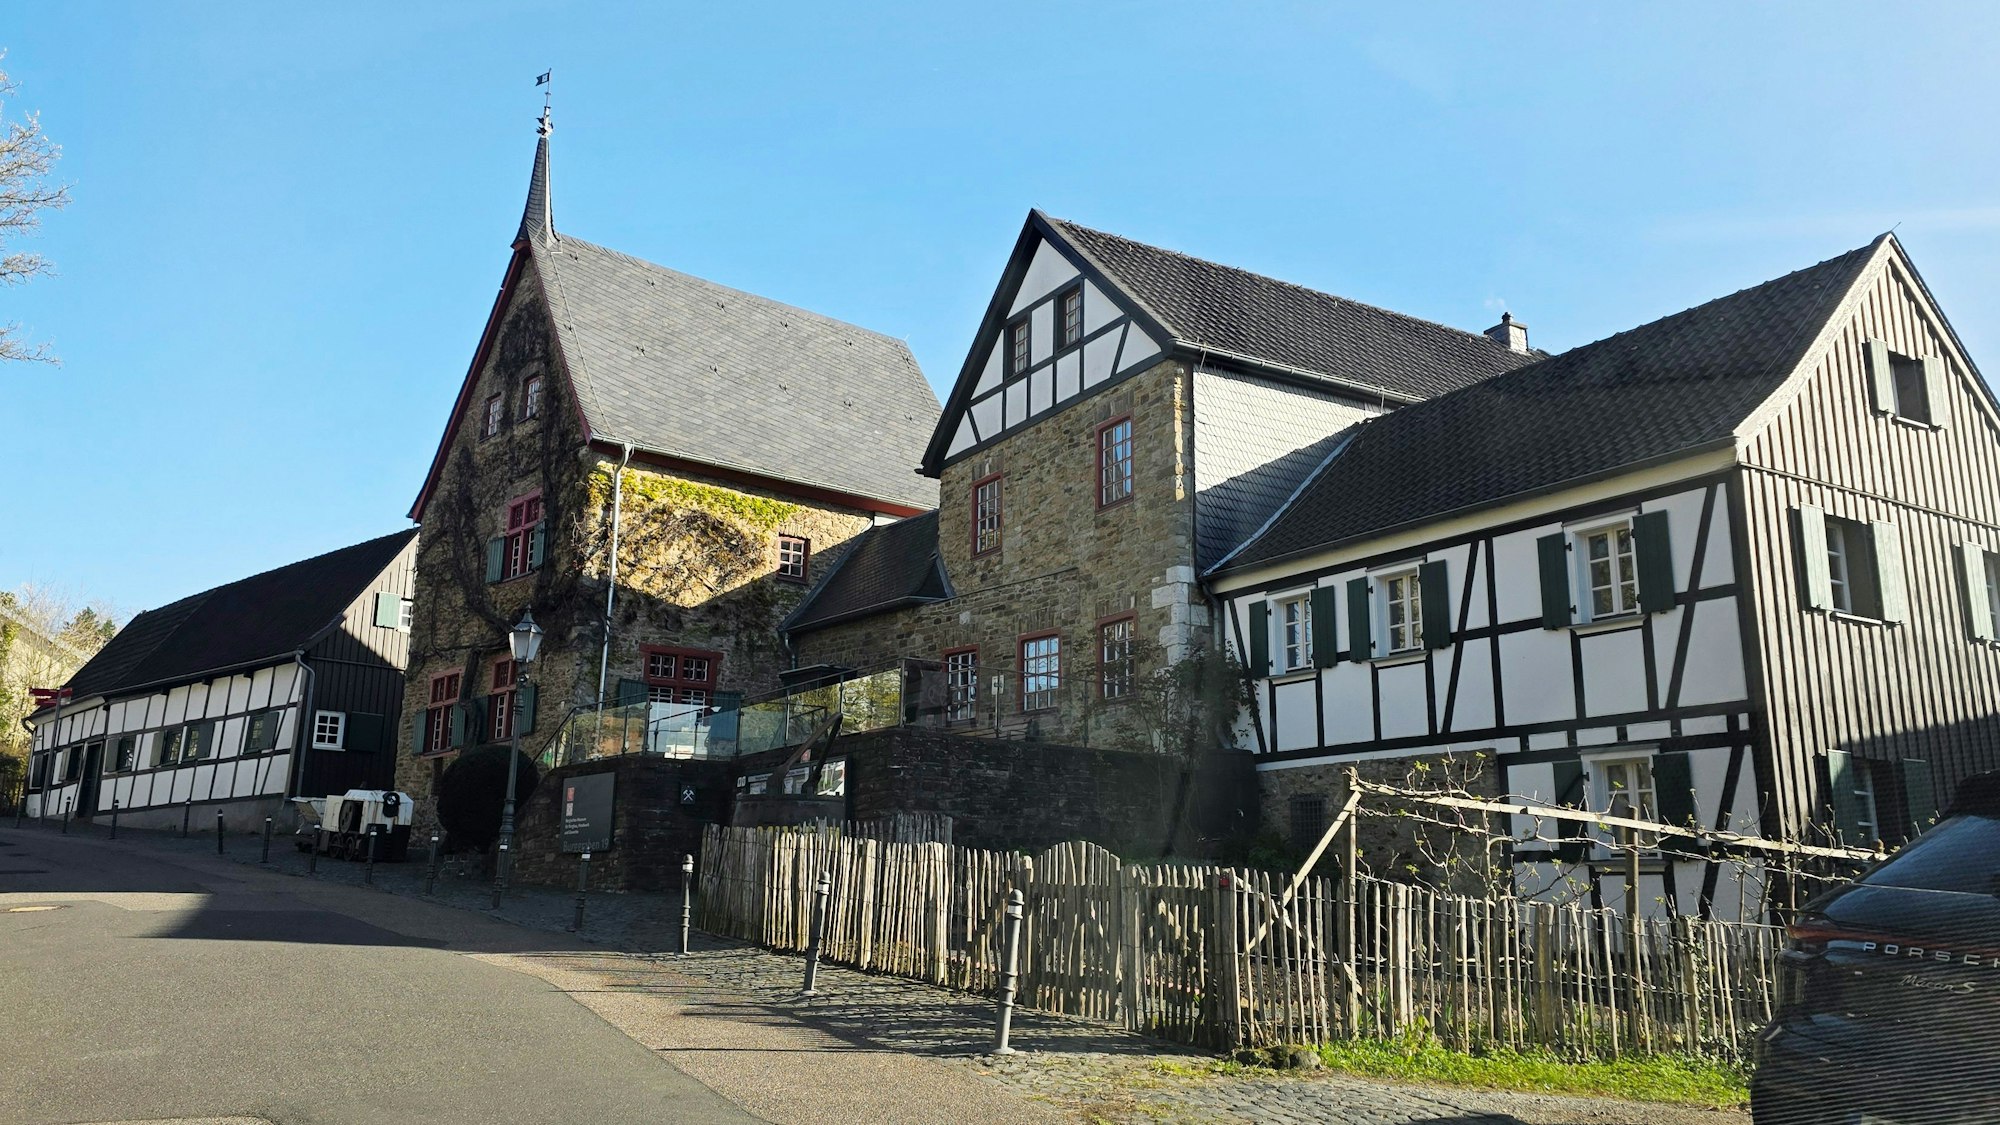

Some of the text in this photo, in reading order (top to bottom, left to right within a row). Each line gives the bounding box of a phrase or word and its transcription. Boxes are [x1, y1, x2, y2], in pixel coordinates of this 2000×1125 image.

[602, 838, 609, 849] 19
[1899, 974, 1977, 994] Macan S
